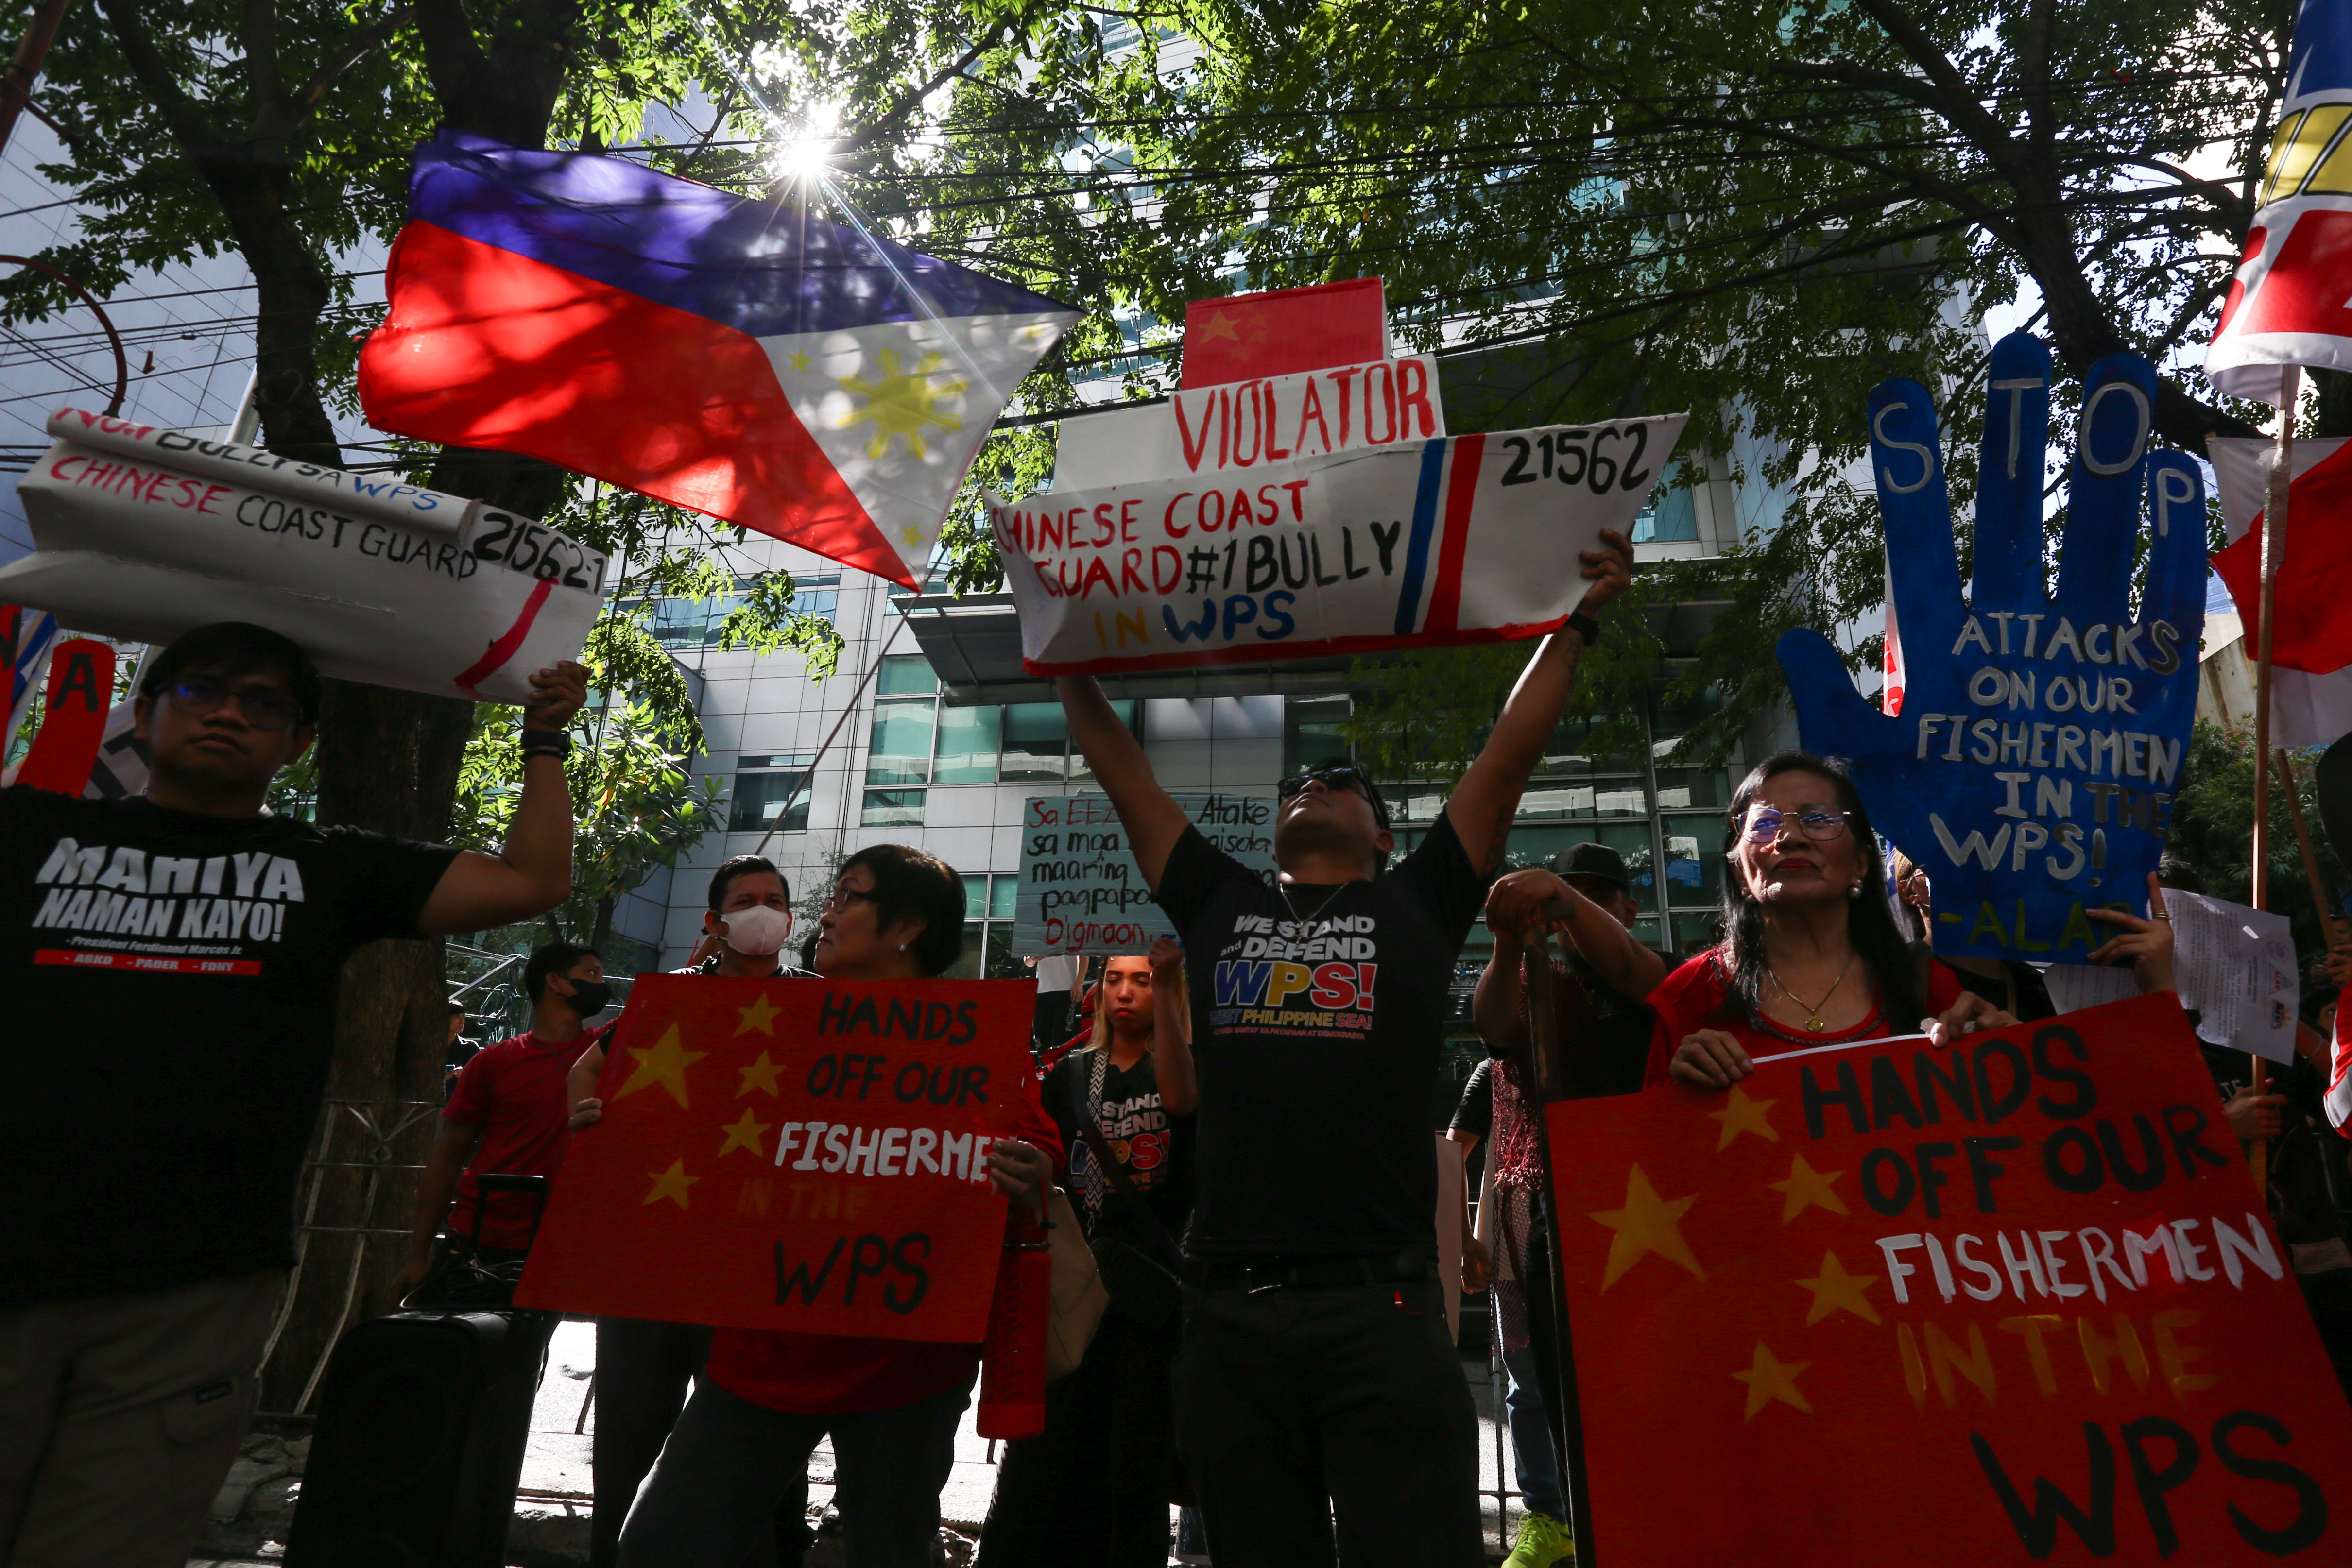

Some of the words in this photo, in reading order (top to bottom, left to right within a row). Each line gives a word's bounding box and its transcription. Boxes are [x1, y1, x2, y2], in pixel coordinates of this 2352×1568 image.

[1175, 358, 1438, 473] VIOLATOR
[295, 464, 340, 486] SA
[354, 476, 444, 510] WPS
[1501, 423, 1651, 495] 21562
[1874, 378, 2195, 536] STOP
[50, 457, 234, 515] CHINESE
[237, 495, 353, 549] COAST
[359, 524, 478, 582] GUARD
[993, 499, 1143, 554] CHINESE
[1164, 479, 1308, 538] COAST
[1096, 607, 1147, 650] IN
[1163, 591, 1296, 644] WPS
[1952, 611, 2180, 675] ATTACKS
[1969, 666, 2035, 711] ON
[2045, 670, 2138, 715] OUR
[1917, 713, 2180, 786] FISHERMEN
[1029, 800, 1058, 828] Sa
[1197, 794, 1270, 825] Atake
[1994, 772, 2072, 818] IN
[2083, 782, 2170, 837] THE
[35, 837, 304, 902] MAHIYA
[1027, 834, 1058, 856] sa
[1930, 812, 2106, 887] WPS!
[32, 888, 176, 937] NAMAN
[177, 899, 285, 942] KAYO!
[1234, 914, 1274, 933] WE
[1277, 914, 1375, 937] STAND
[1220, 940, 1241, 956] and
[1241, 937, 1376, 961] DEFEND
[819, 991, 979, 1044] HANDS
[1216, 960, 1377, 1011] WPS!
[1242, 1009, 1335, 1027] PHILIPPINE
[1335, 1013, 1372, 1030] SEA!
[807, 1053, 888, 1100] OFF
[894, 1061, 990, 1107] OUR
[1800, 1024, 2098, 1138] HANDS
[775, 1121, 1017, 1185] FISHERME
[1860, 1136, 2024, 1217] OFF
[2043, 1104, 2228, 1195] OUR
[737, 1178, 773, 1215] IN
[790, 1181, 873, 1220] THE
[775, 1232, 933, 1314] WPS
[1875, 1213, 2283, 1305] FISHERMEN
[1896, 1320, 1997, 1413] IN
[1999, 1308, 2224, 1403] THE
[1969, 1410, 2328, 1561] WPS
